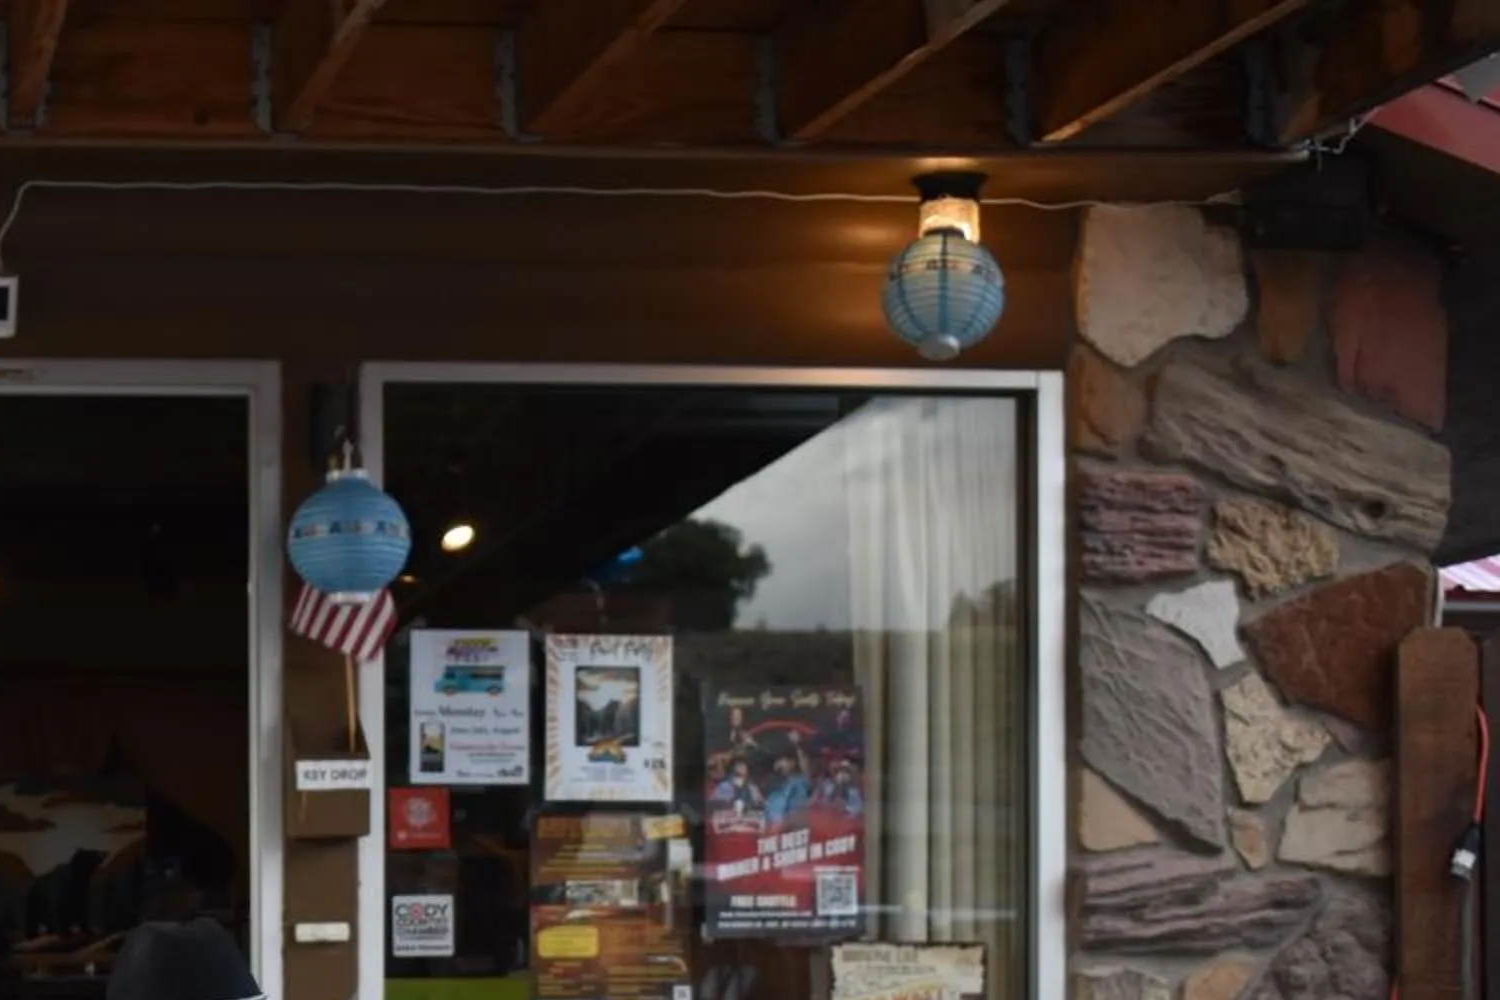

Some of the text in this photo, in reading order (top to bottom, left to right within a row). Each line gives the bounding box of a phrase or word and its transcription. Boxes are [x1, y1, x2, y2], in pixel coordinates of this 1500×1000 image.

[303, 768, 367, 781] KEY DROP
[757, 836, 779, 855] THE
[395, 902, 449, 918] CODY
